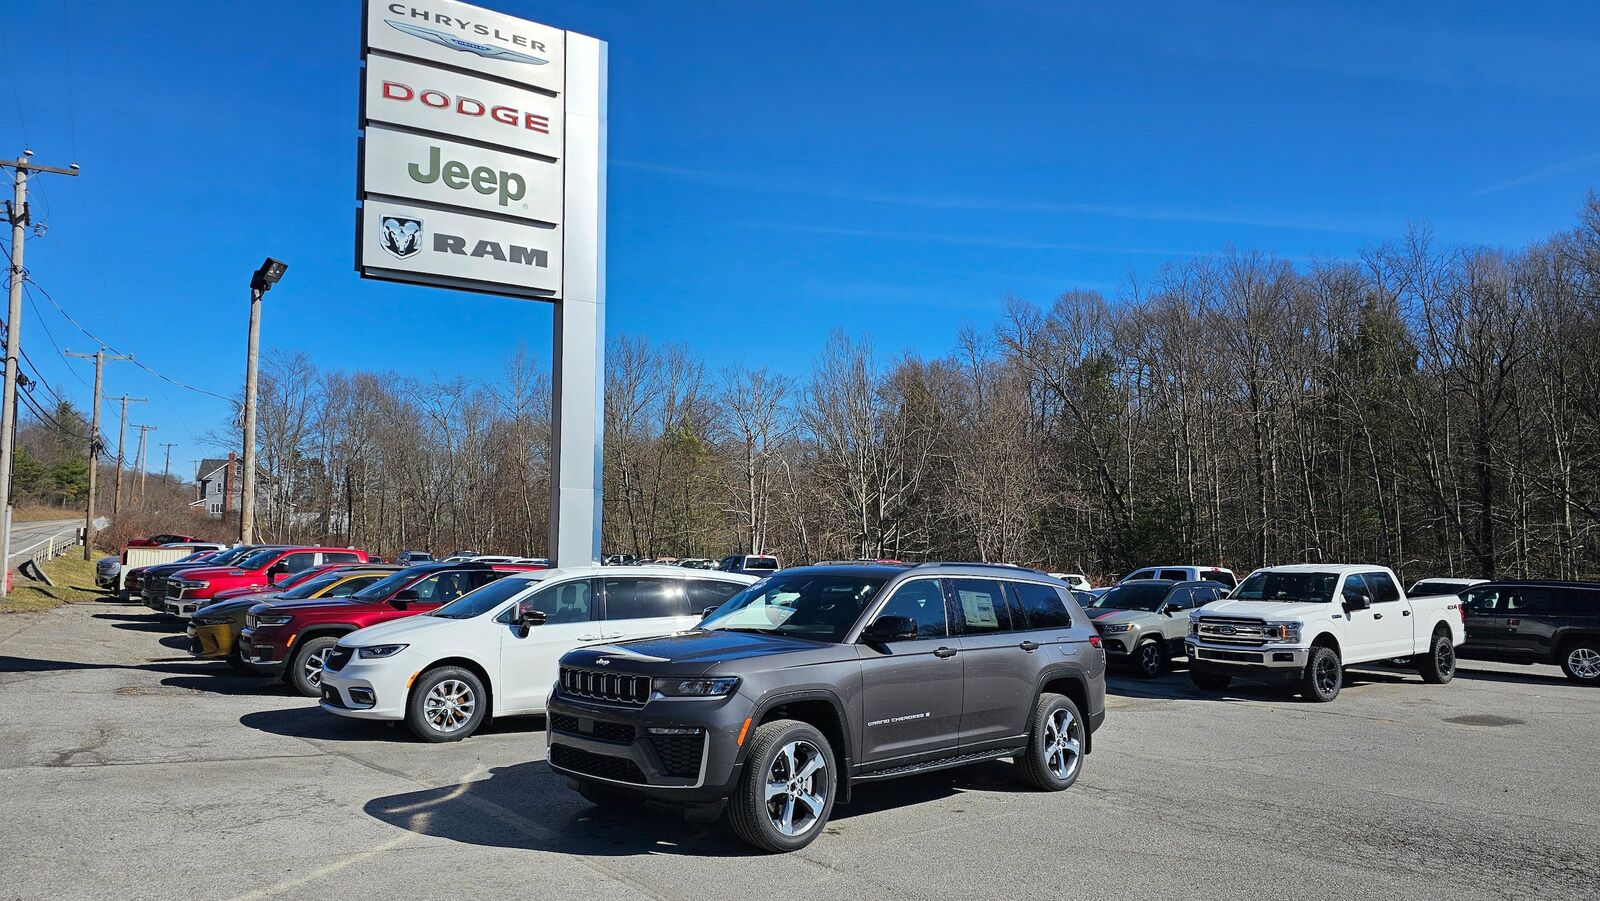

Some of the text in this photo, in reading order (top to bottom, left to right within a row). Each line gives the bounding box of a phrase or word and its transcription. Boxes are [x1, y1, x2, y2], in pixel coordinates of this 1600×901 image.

[388, 3, 546, 53] CHRYSLER
[382, 80, 549, 134] DODGE
[408, 146, 526, 206] Jeep
[433, 233, 548, 268] RAM
[867, 718, 890, 726] GRAND
[891, 713, 924, 723] CHEROKEE
